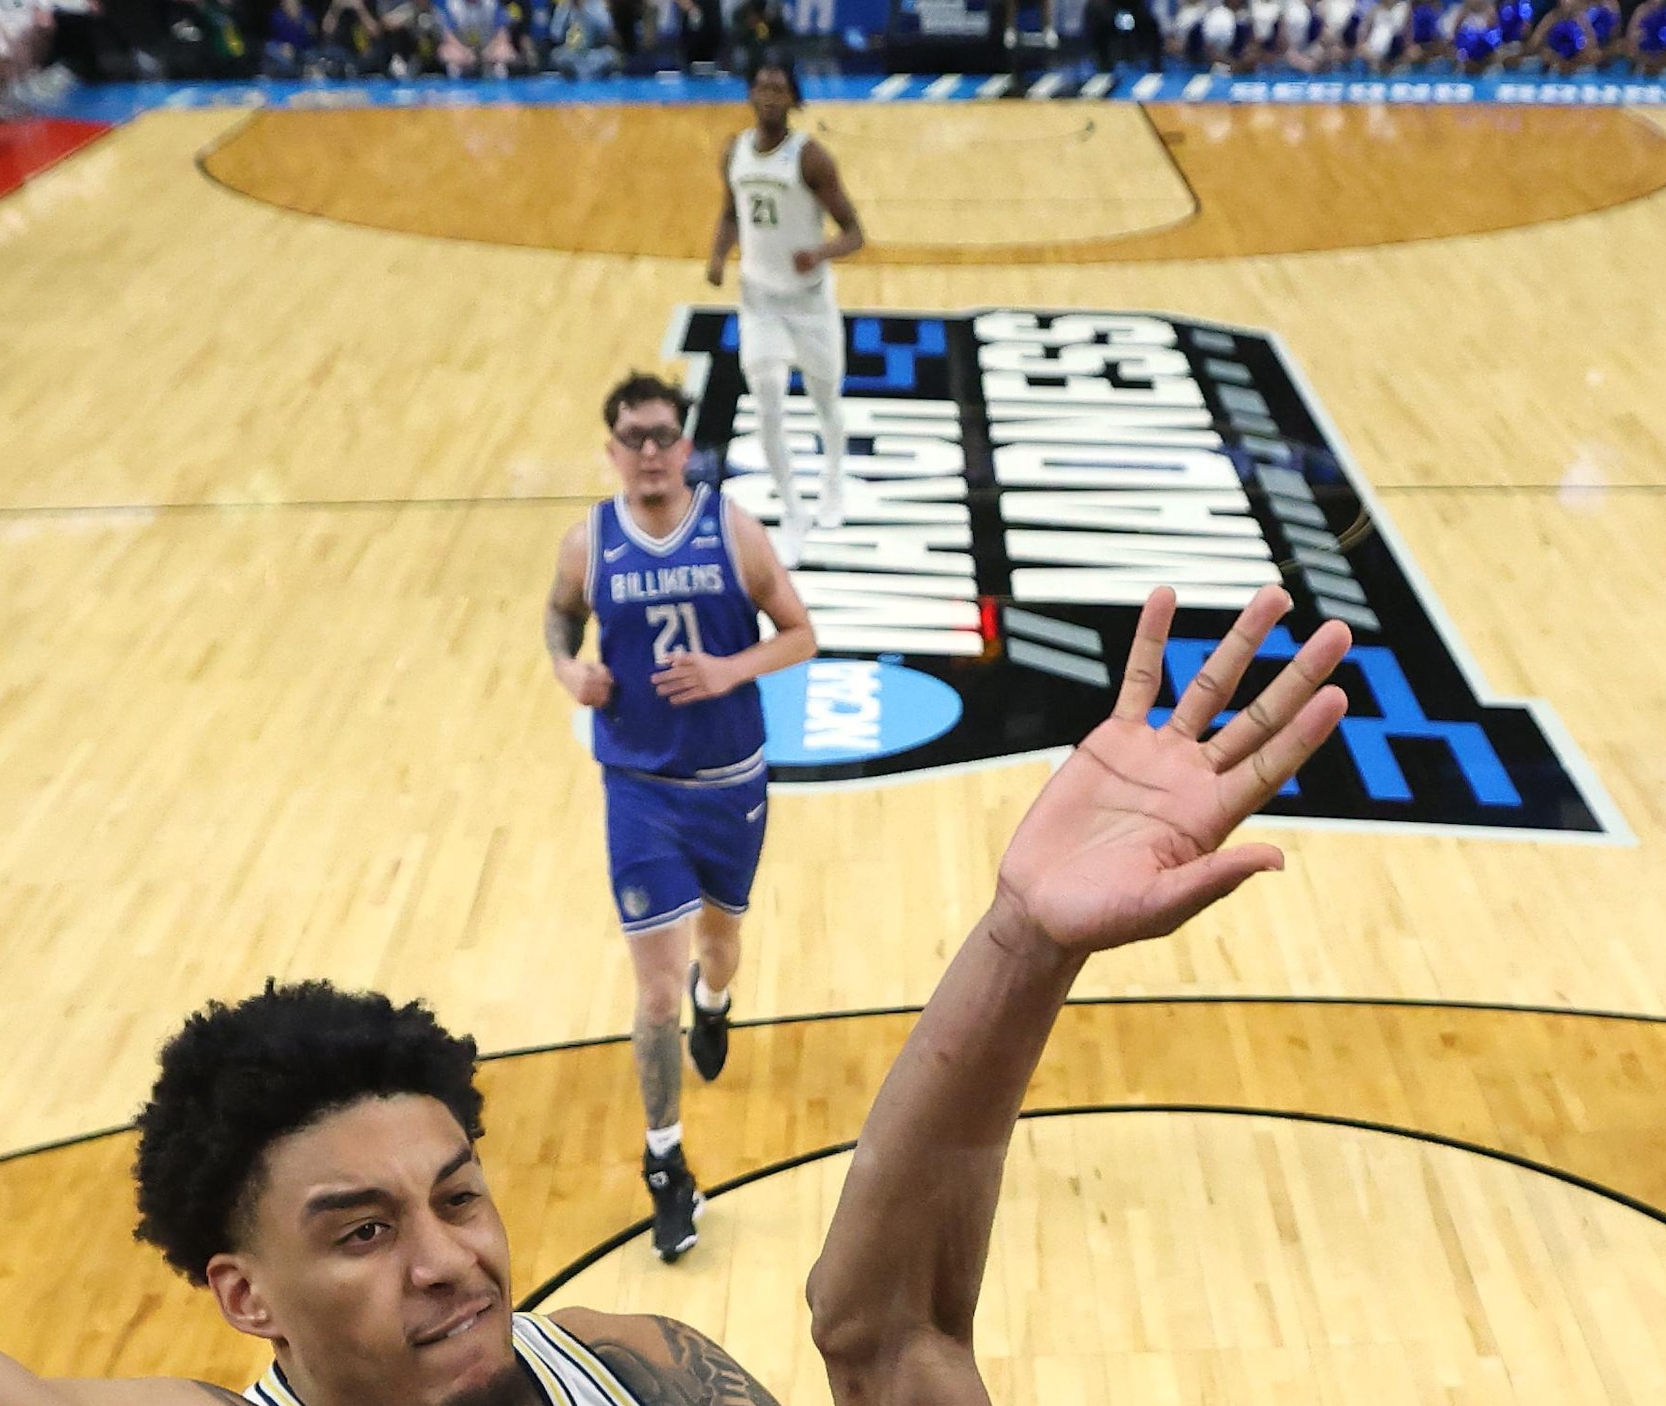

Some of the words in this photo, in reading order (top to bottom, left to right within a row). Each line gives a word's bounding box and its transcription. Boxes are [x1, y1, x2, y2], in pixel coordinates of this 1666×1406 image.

[748, 194, 779, 229] 21
[972, 310, 1293, 610] MADNESS
[720, 393, 986, 658] MARCH
[610, 563, 726, 604] BILLIKENS
[645, 602, 704, 667] 21
[802, 662, 882, 751] NCAA
